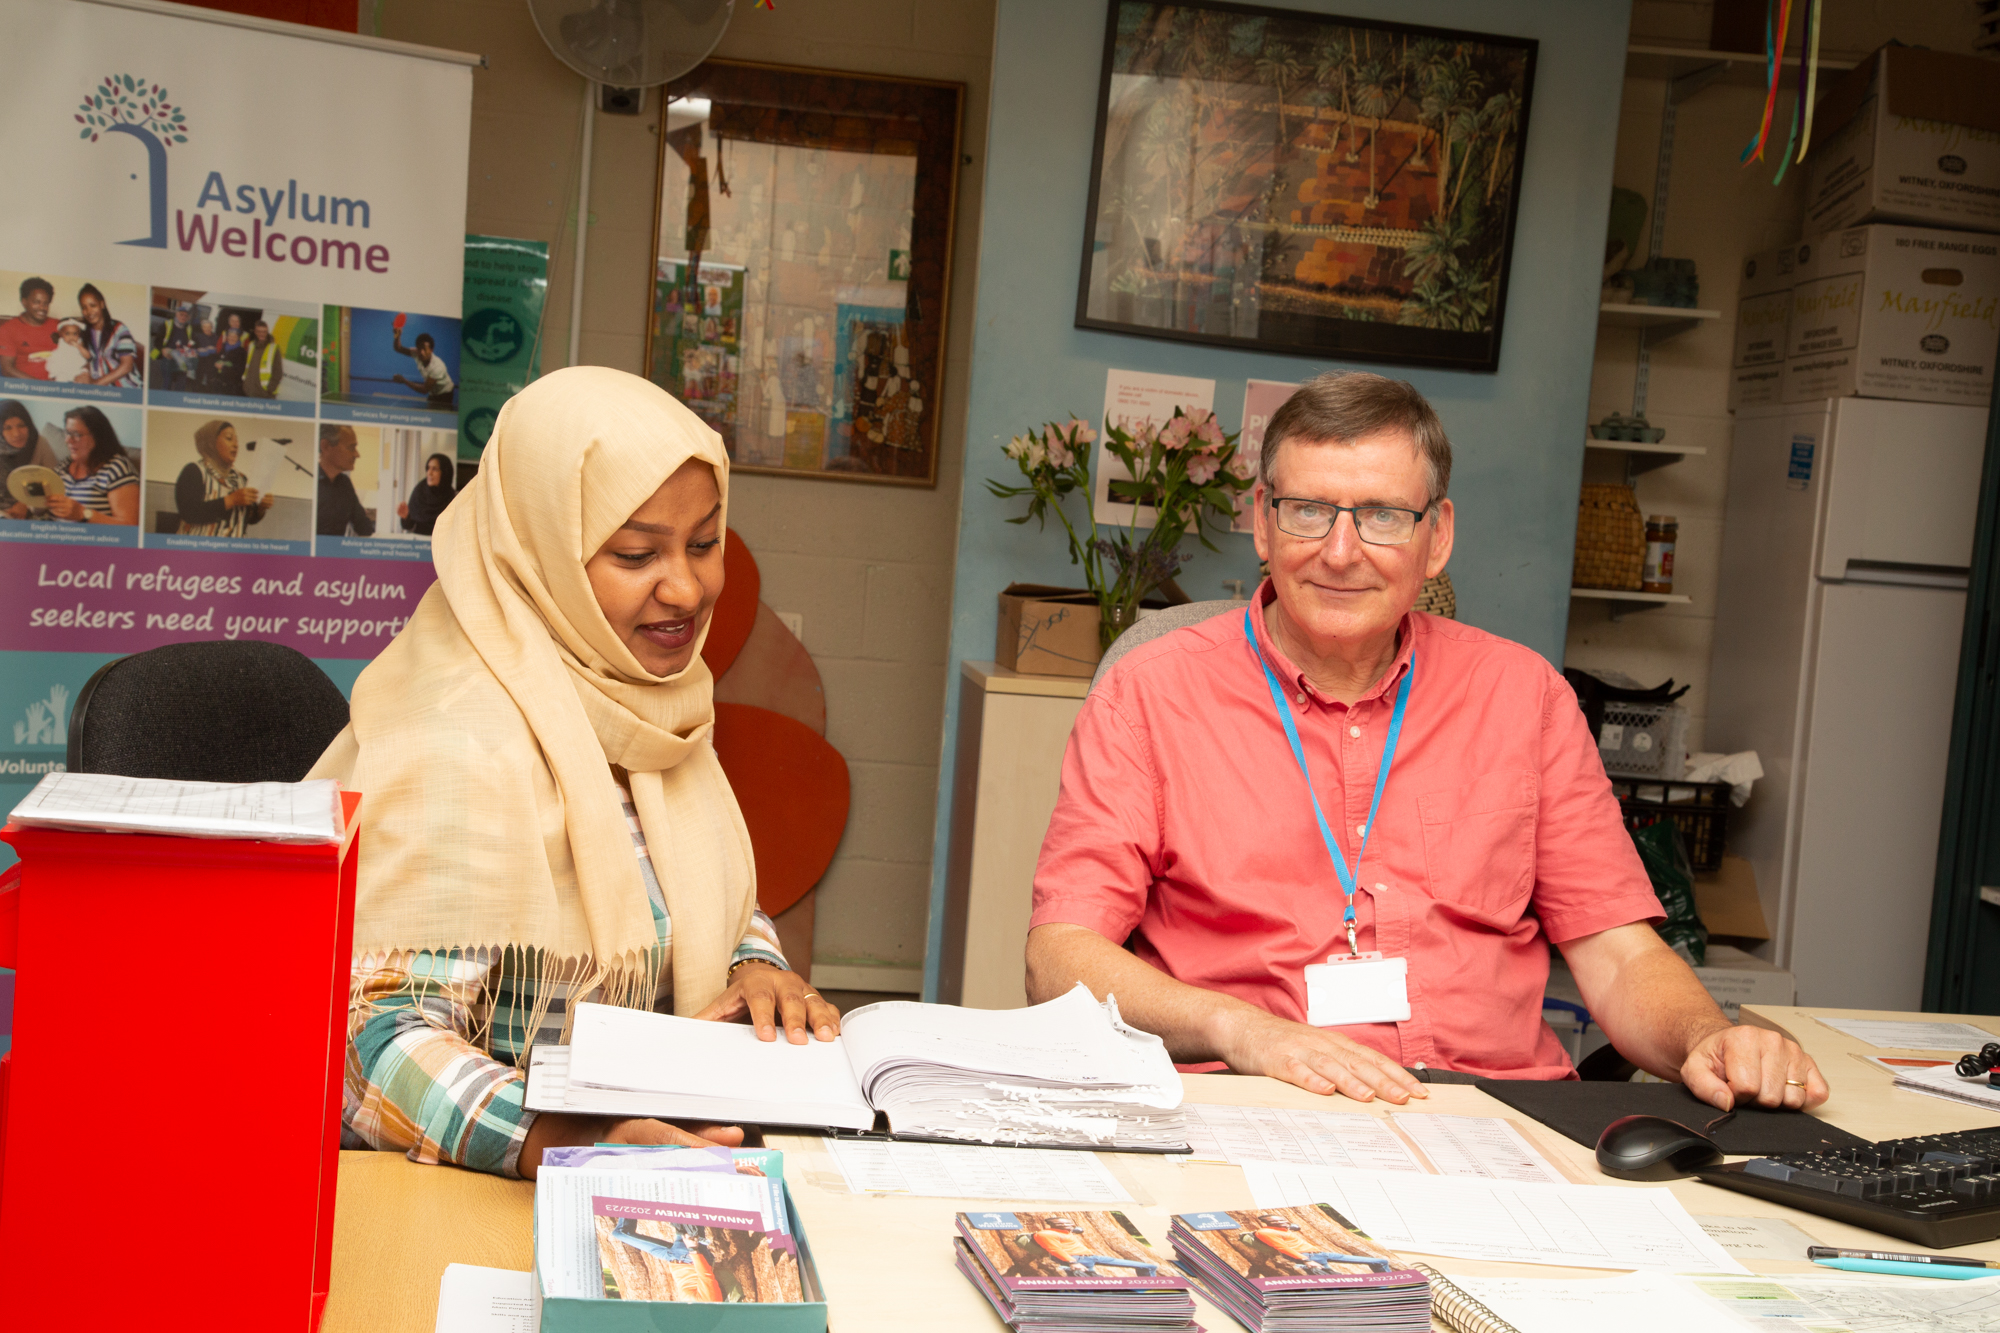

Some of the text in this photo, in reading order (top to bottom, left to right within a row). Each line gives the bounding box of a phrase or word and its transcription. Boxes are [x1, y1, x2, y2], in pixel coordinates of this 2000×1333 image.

[1898, 174, 1936, 189] WITNEY,
[196, 171, 370, 229] Asylum
[176, 209, 390, 274] Welcome
[1895, 238, 1998, 256] 180 FREE RANGE EGGS
[1878, 290, 1999, 331] Mayfield
[1880, 356, 1984, 376] WITNEY, OXFORDSHIRE
[4, 381, 30, 390] Family
[30, 384, 60, 394] support
[30, 523, 58, 533] English
[37, 563, 406, 606] Local refugees and asylum
[28, 602, 136, 630] seekers
[146, 606, 214, 632] need
[223, 615, 290, 641] your
[0, 758, 66, 774] Volunte
[739, 1156, 768, 1168] HIV?
[605, 1204, 754, 1225] ANNUAL REVIEW 2022/23
[1264, 1273, 1413, 1286] ANNUAL REVIEW 2022/23
